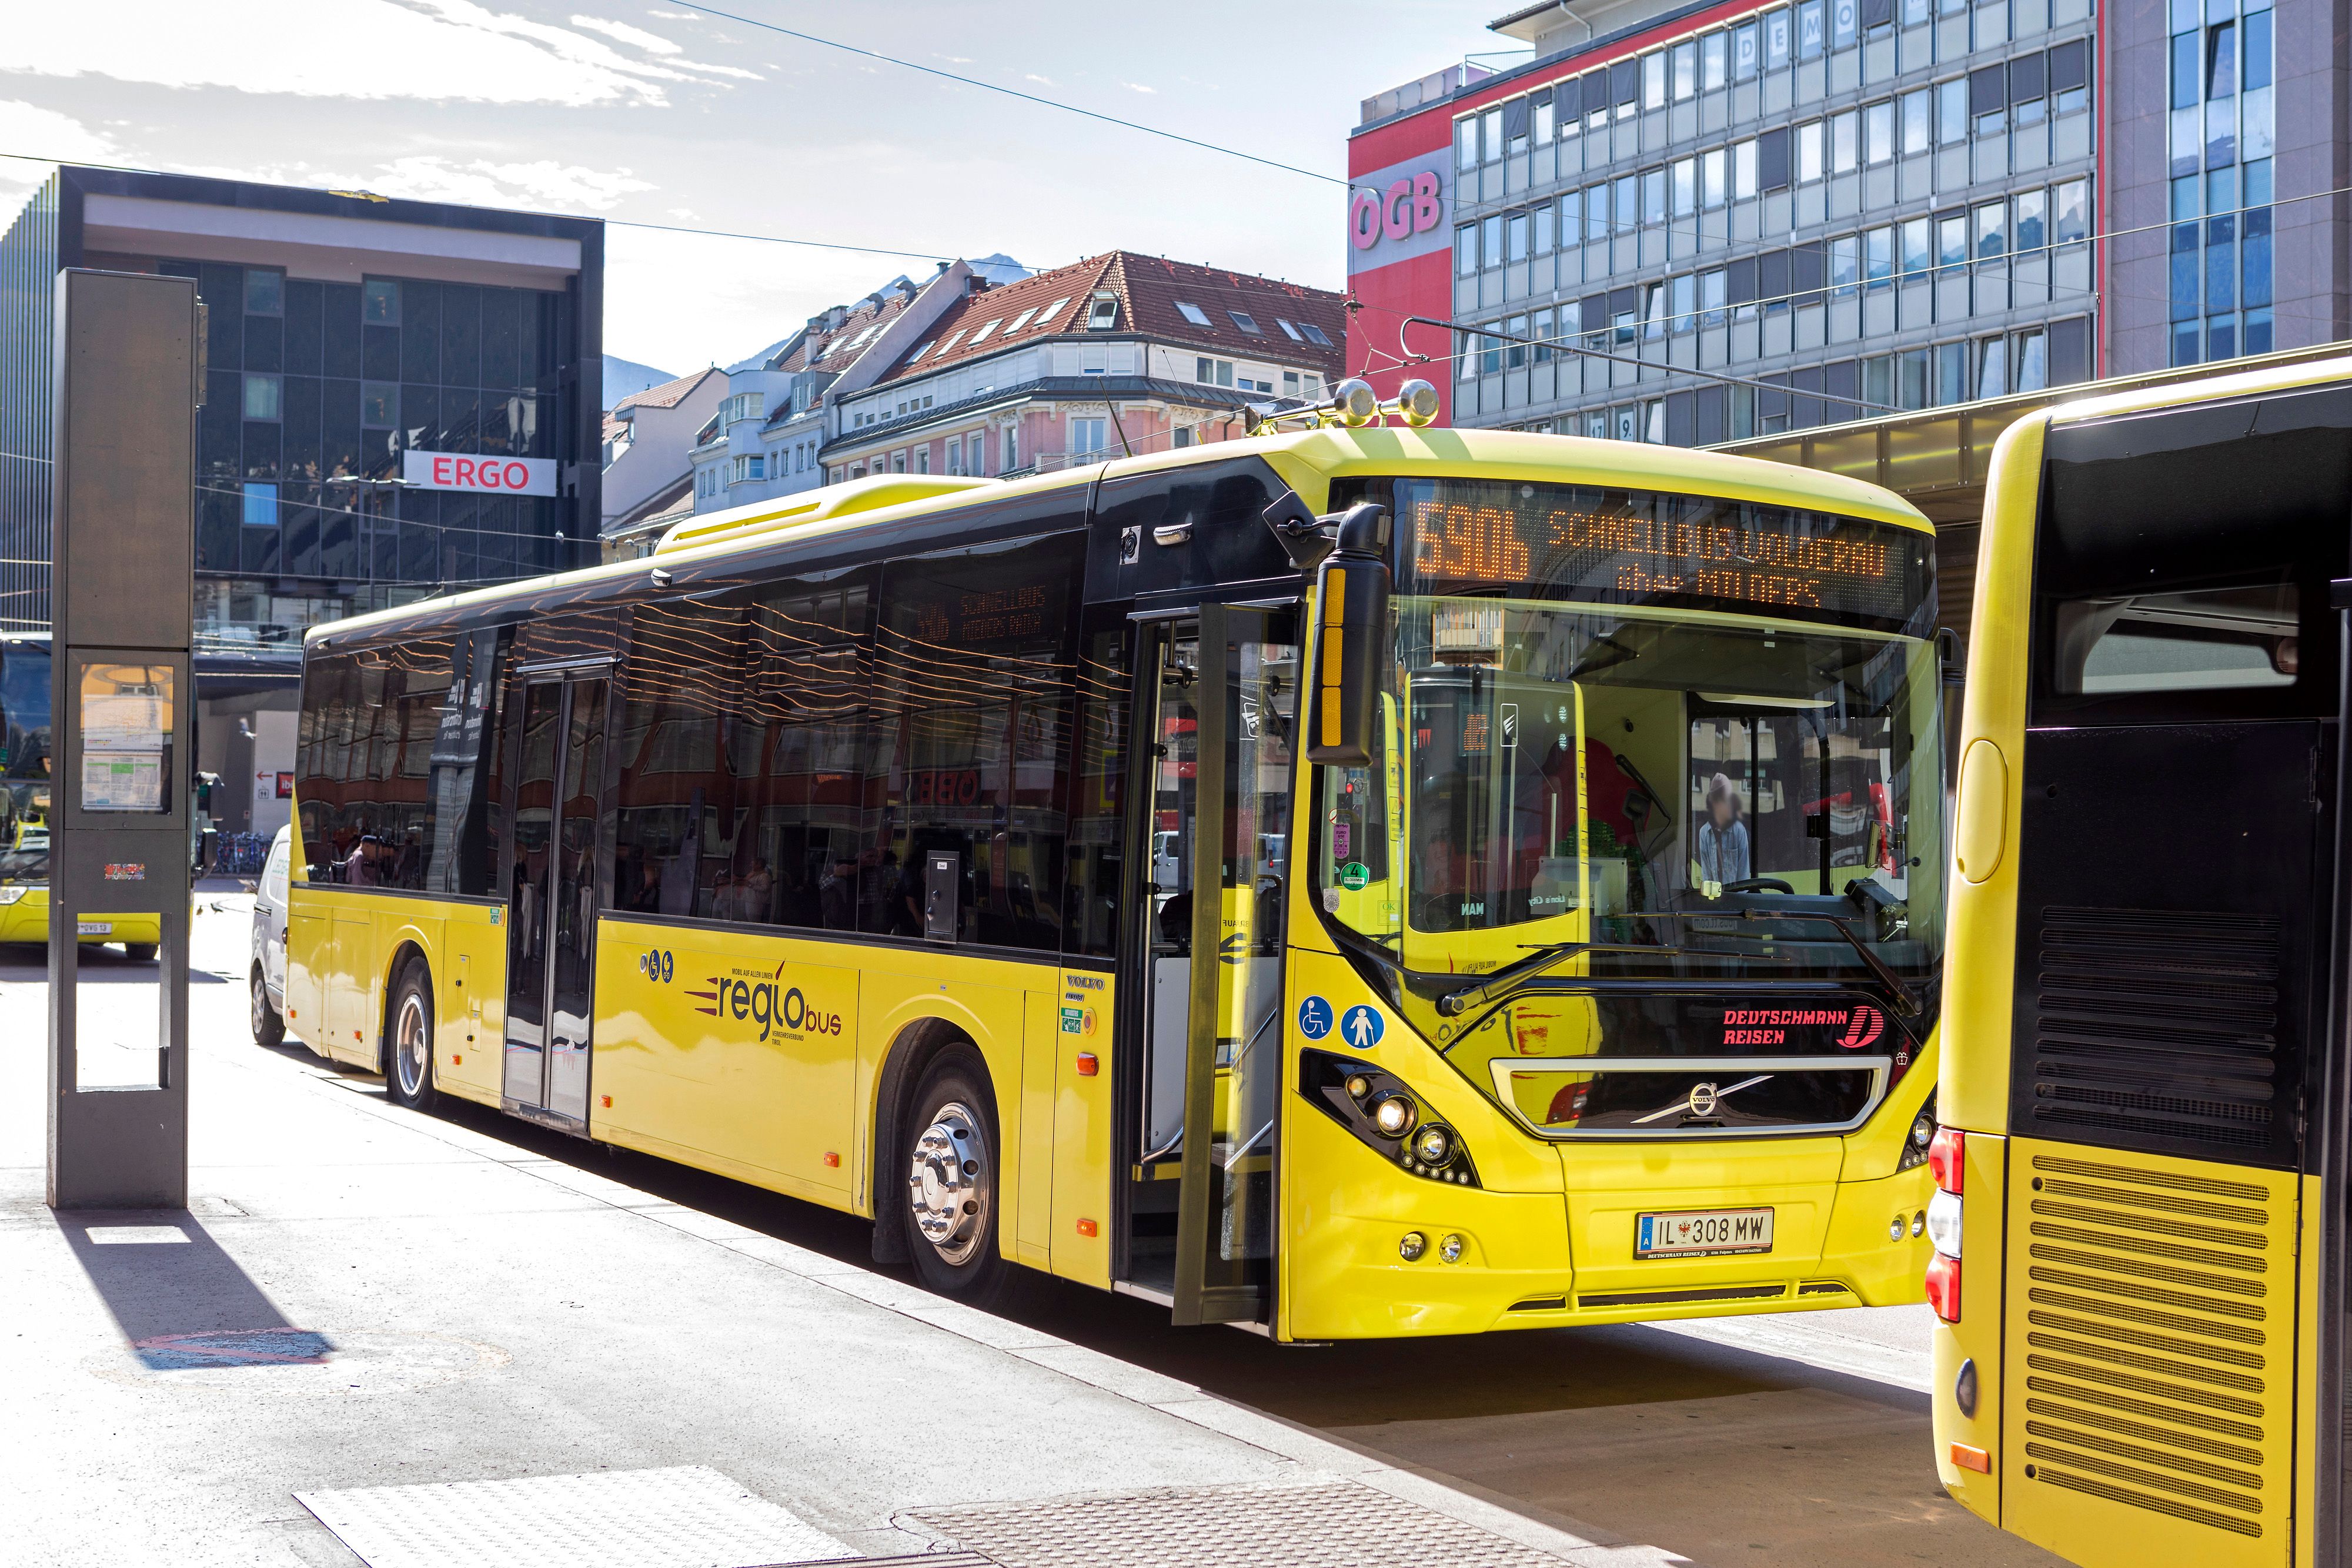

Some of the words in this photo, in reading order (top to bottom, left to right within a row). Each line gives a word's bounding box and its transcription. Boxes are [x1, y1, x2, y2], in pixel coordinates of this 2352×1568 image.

[433, 457, 529, 490] ERGO
[1548, 511, 1731, 560] SCHNELLBUS
[1350, 864, 1359, 877] 4
[1382, 902, 1395, 911] OK
[1066, 975, 1105, 991] VOLVO
[1723, 1011, 1847, 1024] DEUTSCHMANN
[772, 1030, 804, 1041] VERKEHRSVERBUND
[1723, 1030, 1785, 1044] REISEN
[1659, 1221, 1675, 1245] IL
[1693, 1218, 1729, 1243] 308
[1735, 1216, 1763, 1241] MW
